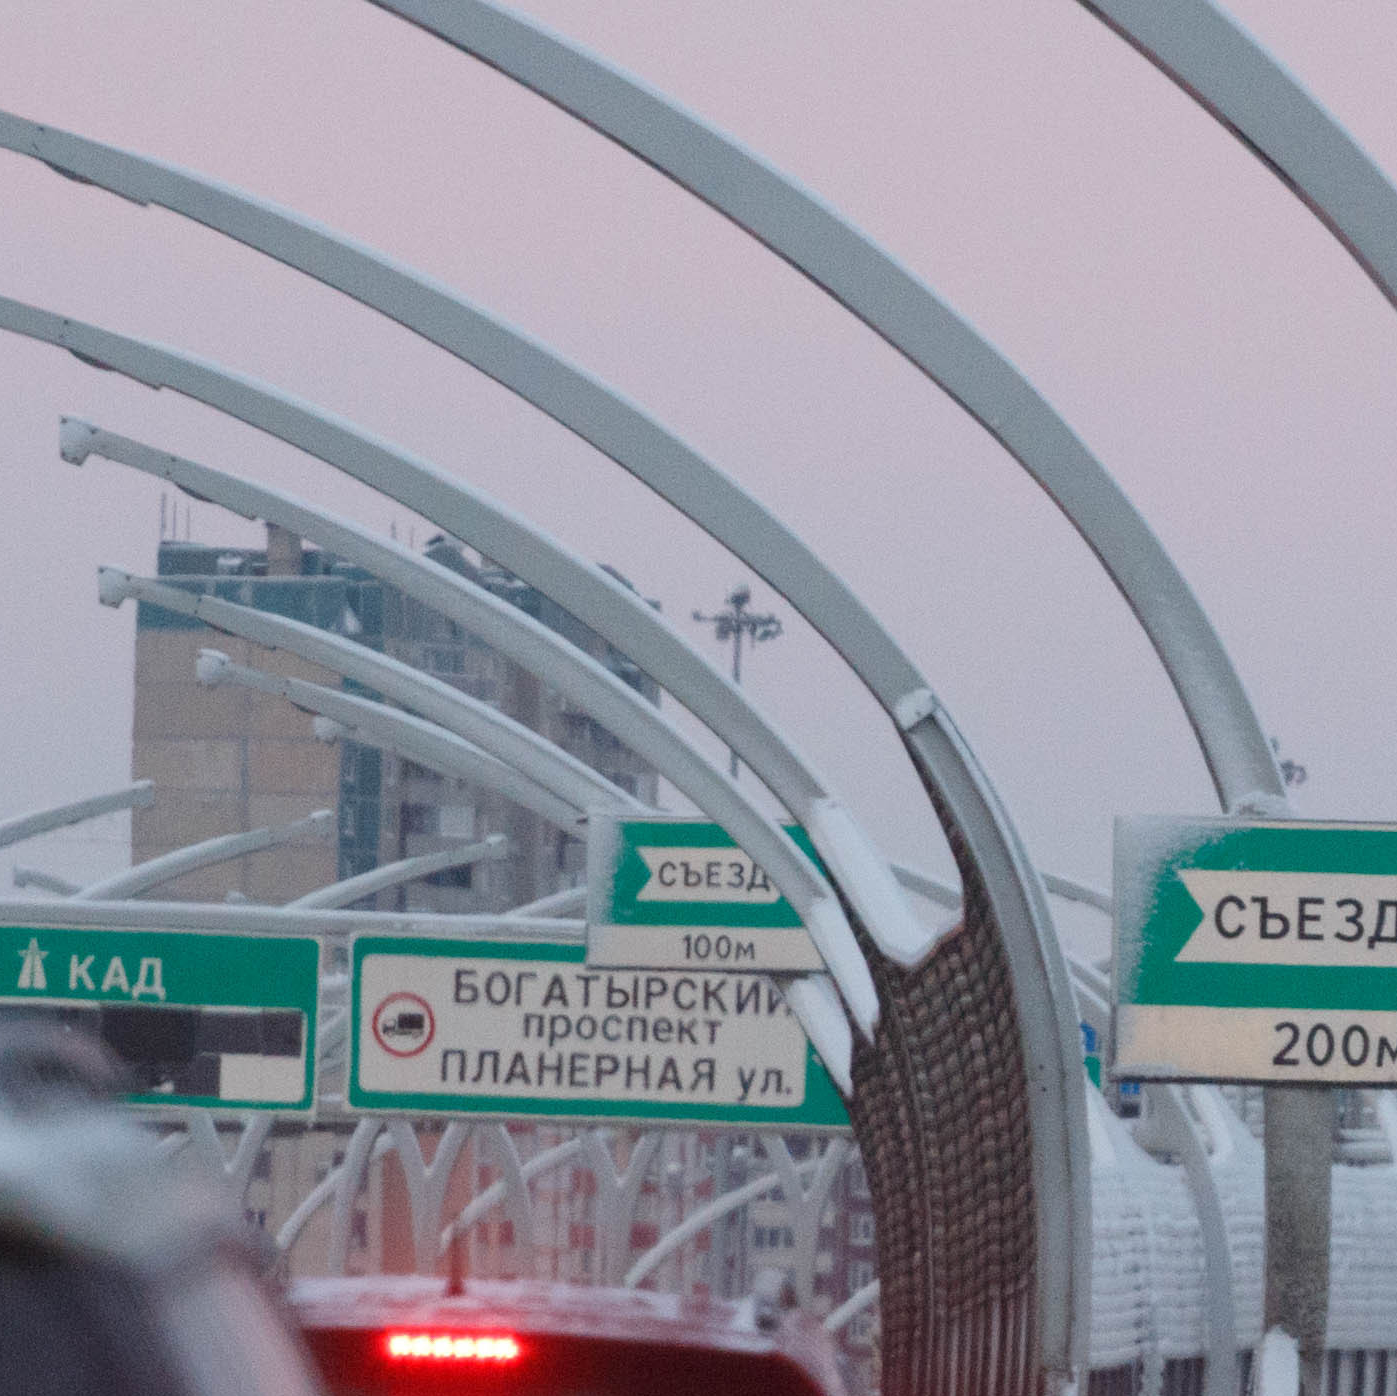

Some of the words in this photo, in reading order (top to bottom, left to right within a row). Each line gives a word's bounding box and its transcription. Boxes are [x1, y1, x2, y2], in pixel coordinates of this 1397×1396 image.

[658, 861, 771, 892] СЪЕЗД
[683, 934, 756, 961] 100м
[69, 954, 166, 1001] КАД
[523, 1012, 722, 1048] проспект
[441, 1049, 716, 1093] ПЛАНЕРНАЯ
[737, 1066, 794, 1104] ул.
